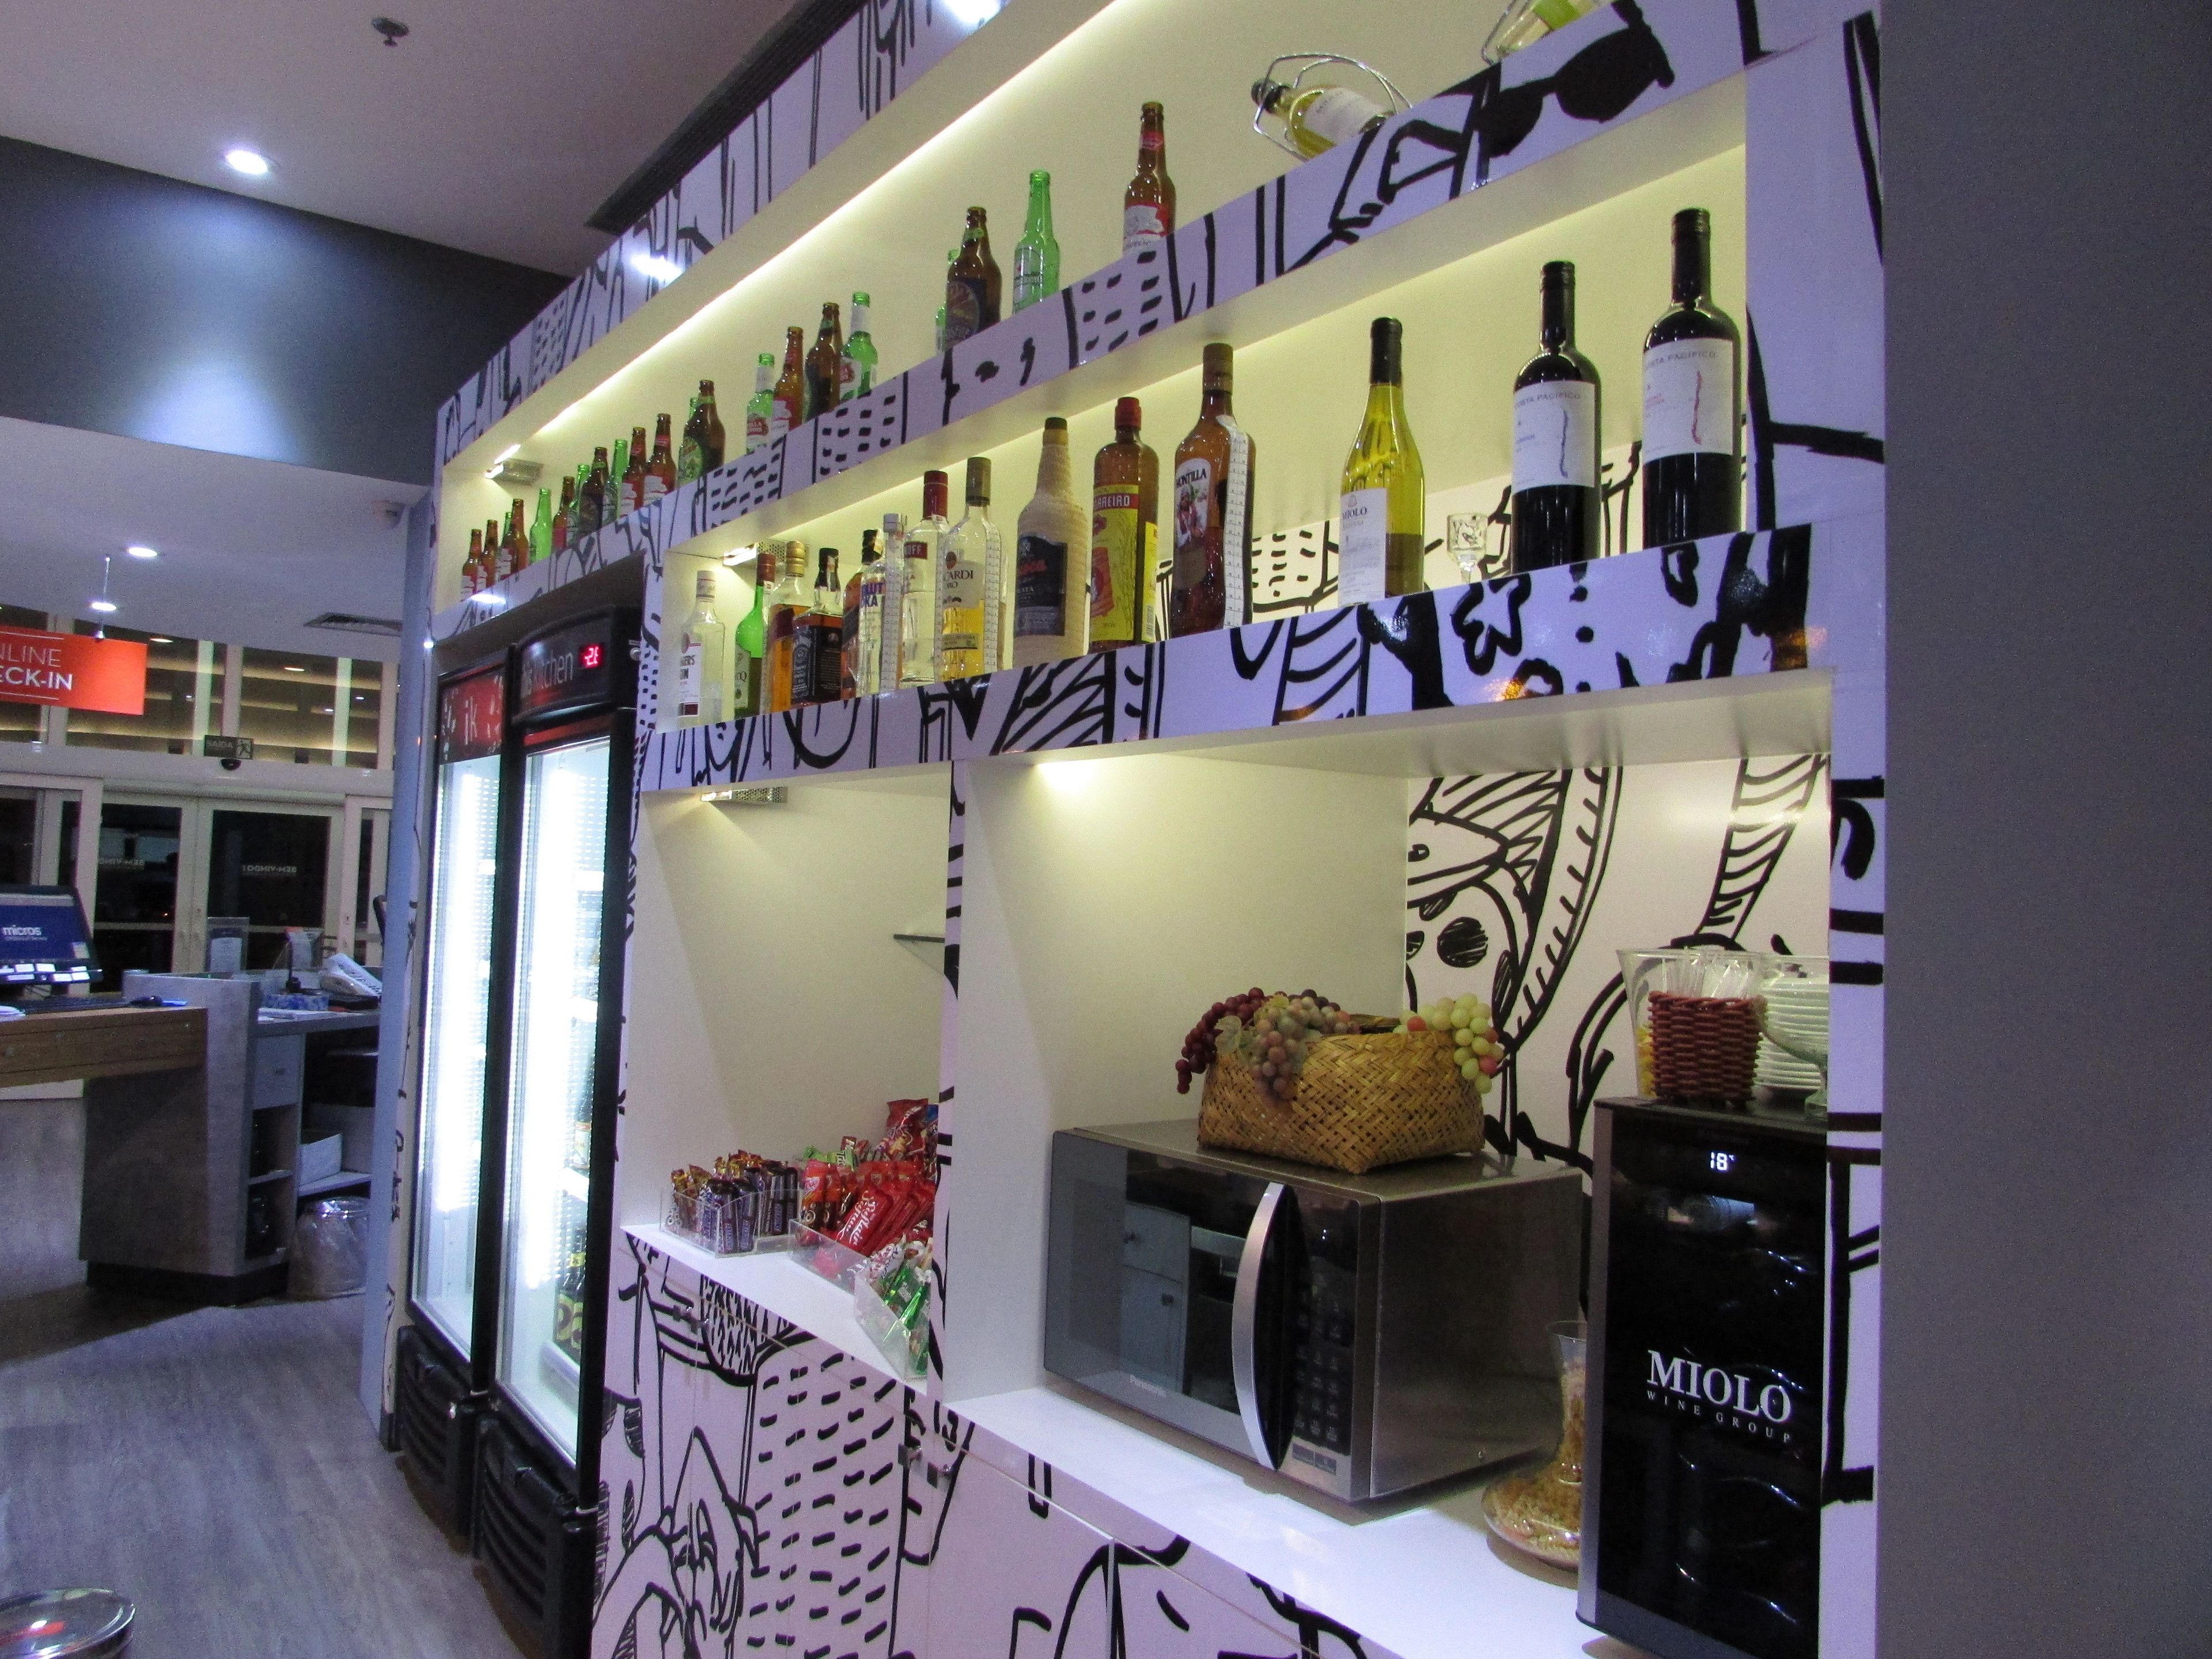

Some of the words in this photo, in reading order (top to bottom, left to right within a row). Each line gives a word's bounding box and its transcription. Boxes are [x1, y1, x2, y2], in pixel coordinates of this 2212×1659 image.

[2, 925, 42, 935] micros
[1646, 1349, 1791, 1423] MIOLO
[1647, 1389, 1701, 1415] WINE
[1715, 1411, 1790, 1443] GROUP
